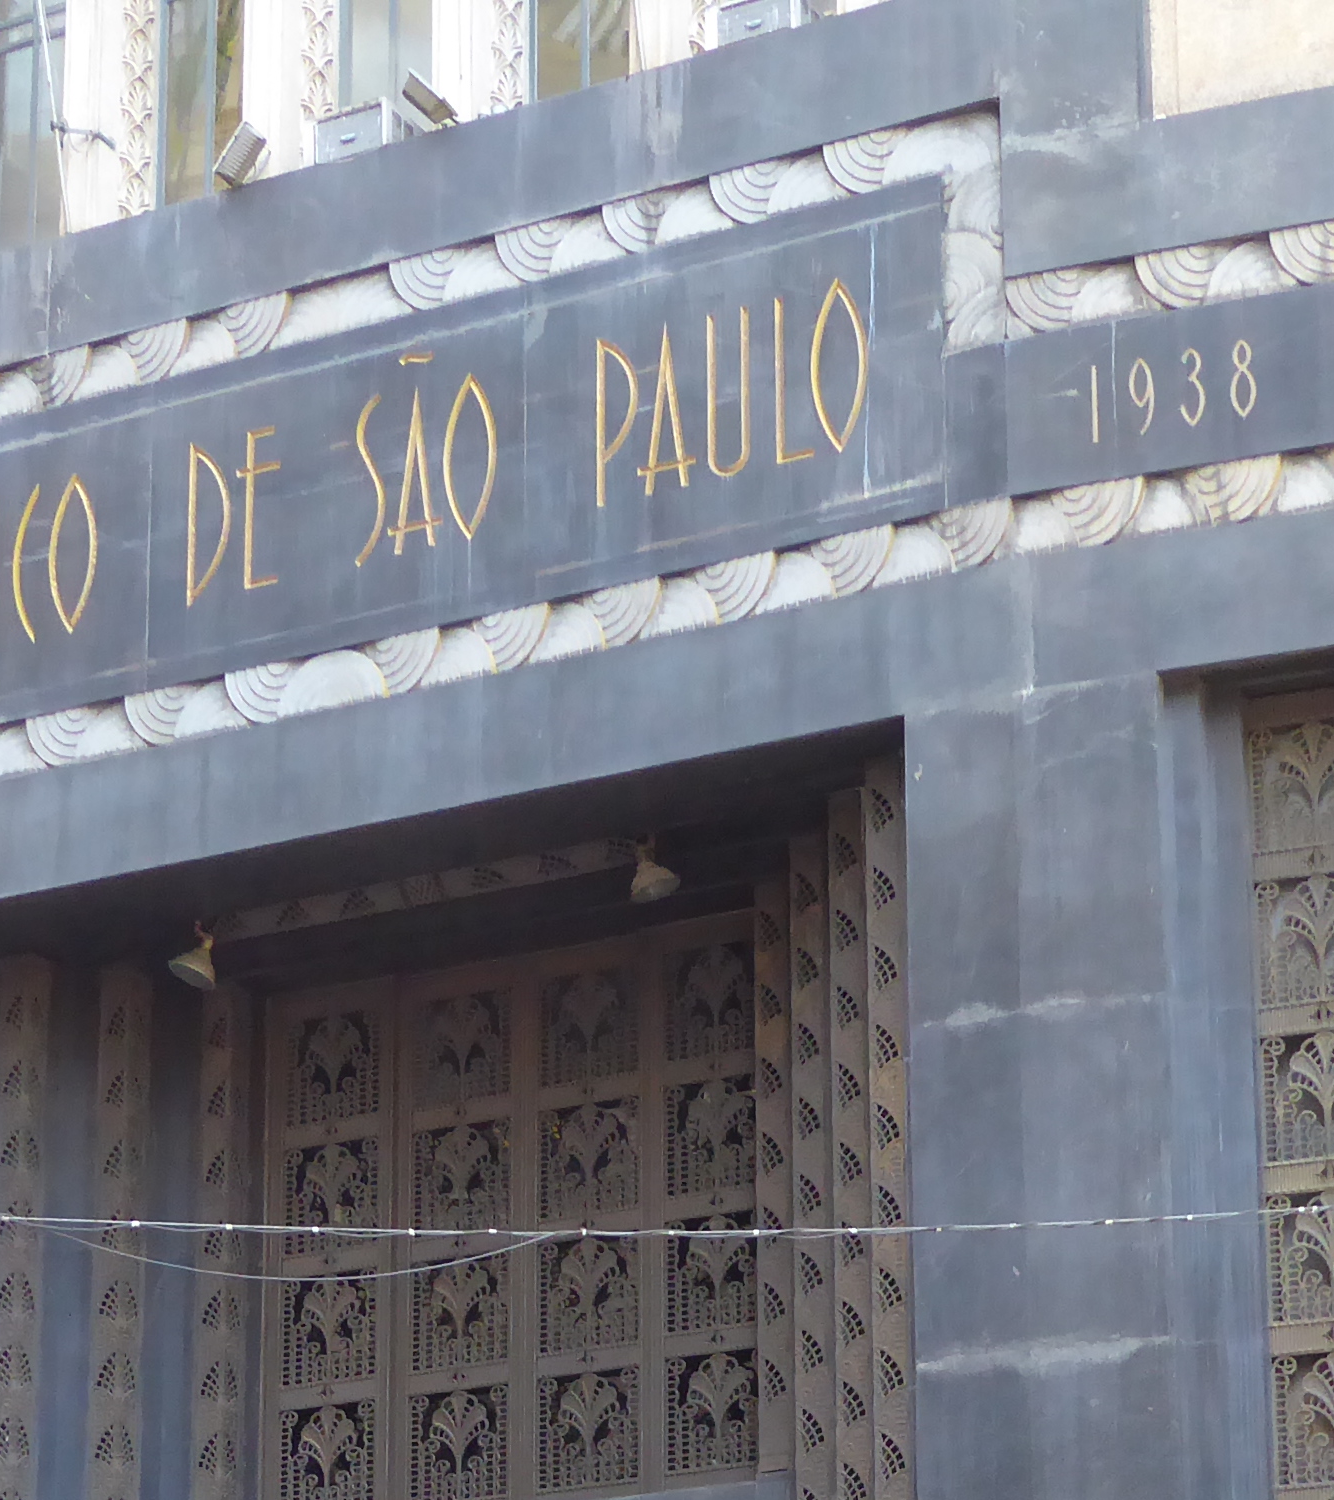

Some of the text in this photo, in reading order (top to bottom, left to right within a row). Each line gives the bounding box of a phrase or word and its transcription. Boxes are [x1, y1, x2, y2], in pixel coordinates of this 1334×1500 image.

[184, 425, 281, 607] DE
[353, 350, 498, 568] SÃO
[595, 277, 869, 507] PAULO
[1087, 337, 1259, 444] 1938
